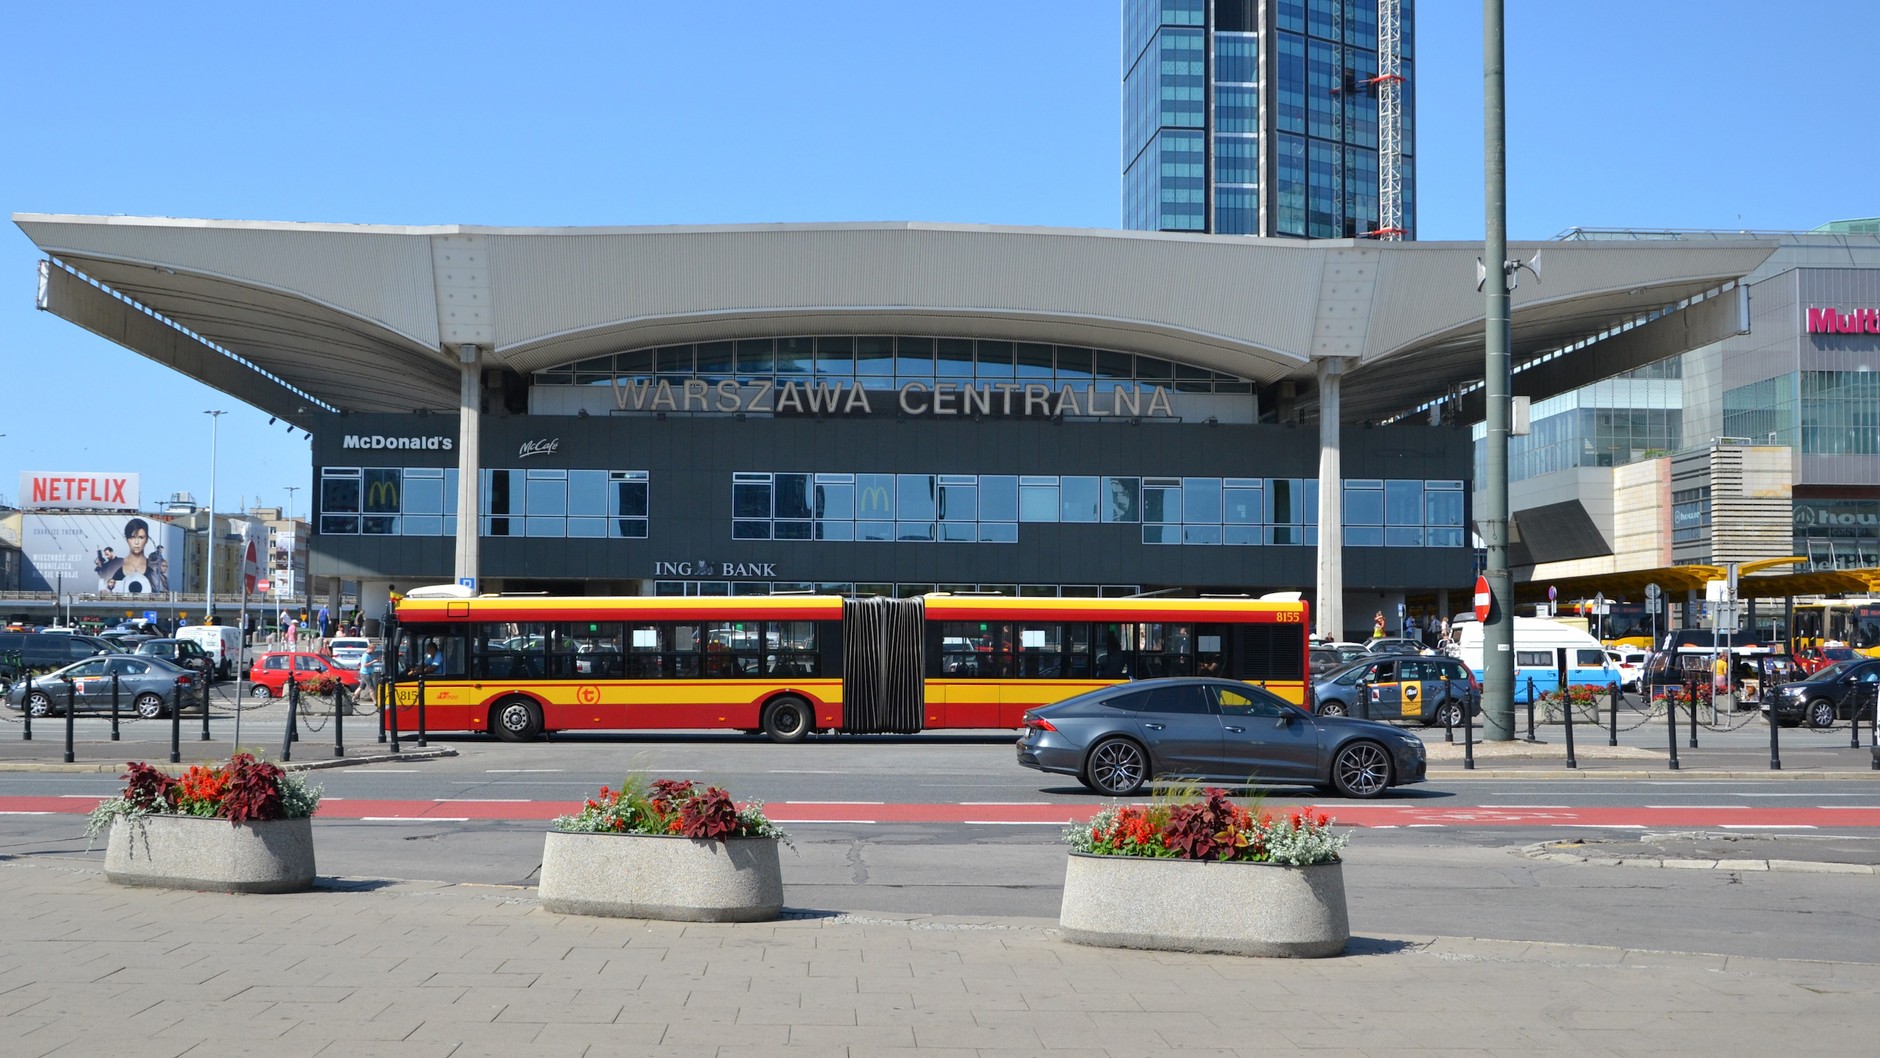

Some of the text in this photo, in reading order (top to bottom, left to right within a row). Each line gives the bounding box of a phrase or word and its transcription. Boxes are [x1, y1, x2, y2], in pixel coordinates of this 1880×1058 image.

[1806, 308, 1880, 333] Mult
[611, 378, 1174, 416] WARSZAWA CENTRALNA
[343, 435, 453, 450] McDonald's
[519, 438, 559, 458] McCafé
[33, 477, 126, 503] NETFLIX
[1819, 510, 1880, 525] hou
[655, 561, 777, 577] ING BANK
[1276, 612, 1300, 622] 8155
[400, 690, 420, 701] 815
